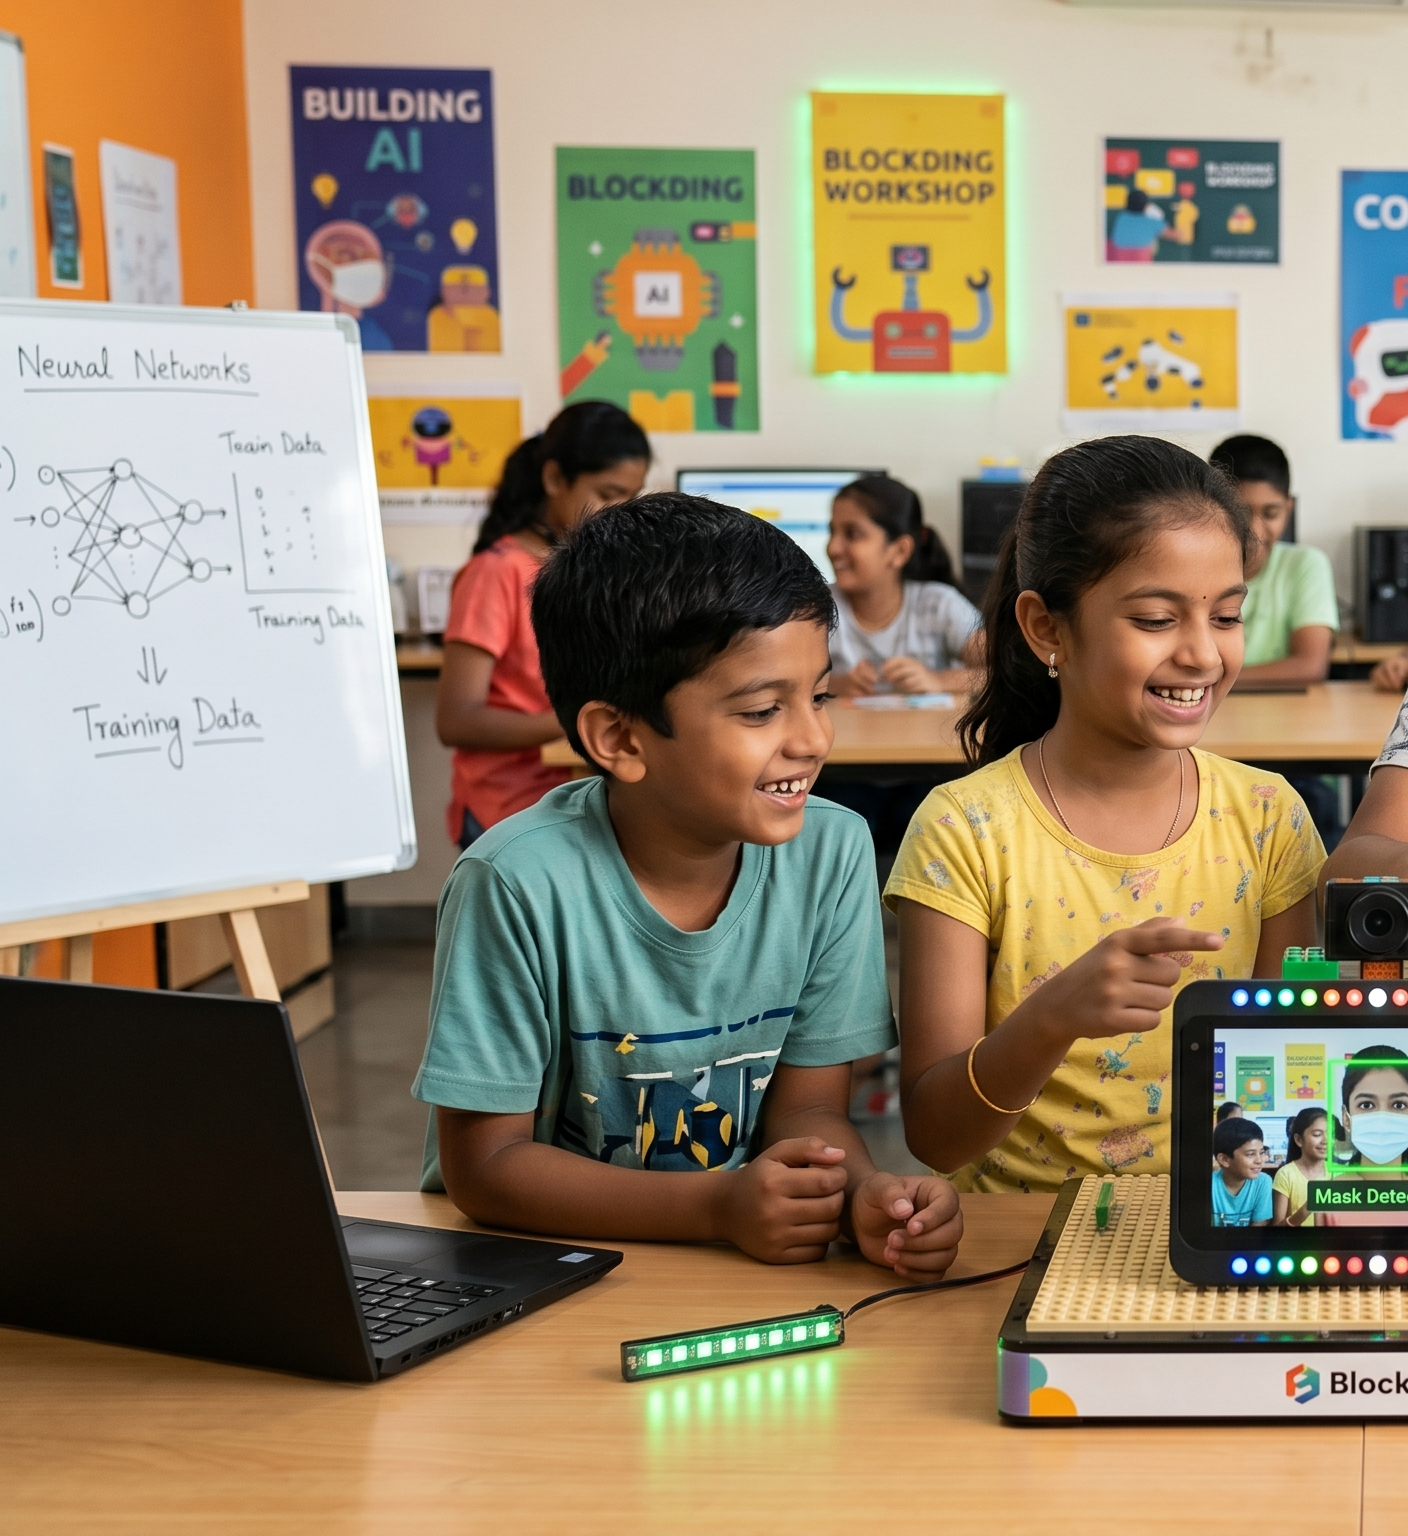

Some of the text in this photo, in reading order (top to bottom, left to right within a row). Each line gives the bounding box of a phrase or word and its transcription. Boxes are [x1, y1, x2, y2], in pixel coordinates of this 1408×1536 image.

[303, 87, 482, 124] BUILDING
[365, 127, 424, 173] AI
[823, 147, 994, 174] BLOCKDING
[568, 173, 744, 203] BLOCKDING
[824, 179, 995, 205] WORKSHOP
[647, 284, 670, 304] AI
[18, 345, 252, 385] Neural Networks
[281, 432, 326, 455] Data
[249, 605, 365, 645] Training Data
[72, 697, 262, 770] Training Data
[1315, 1187, 1362, 1205] Mask
